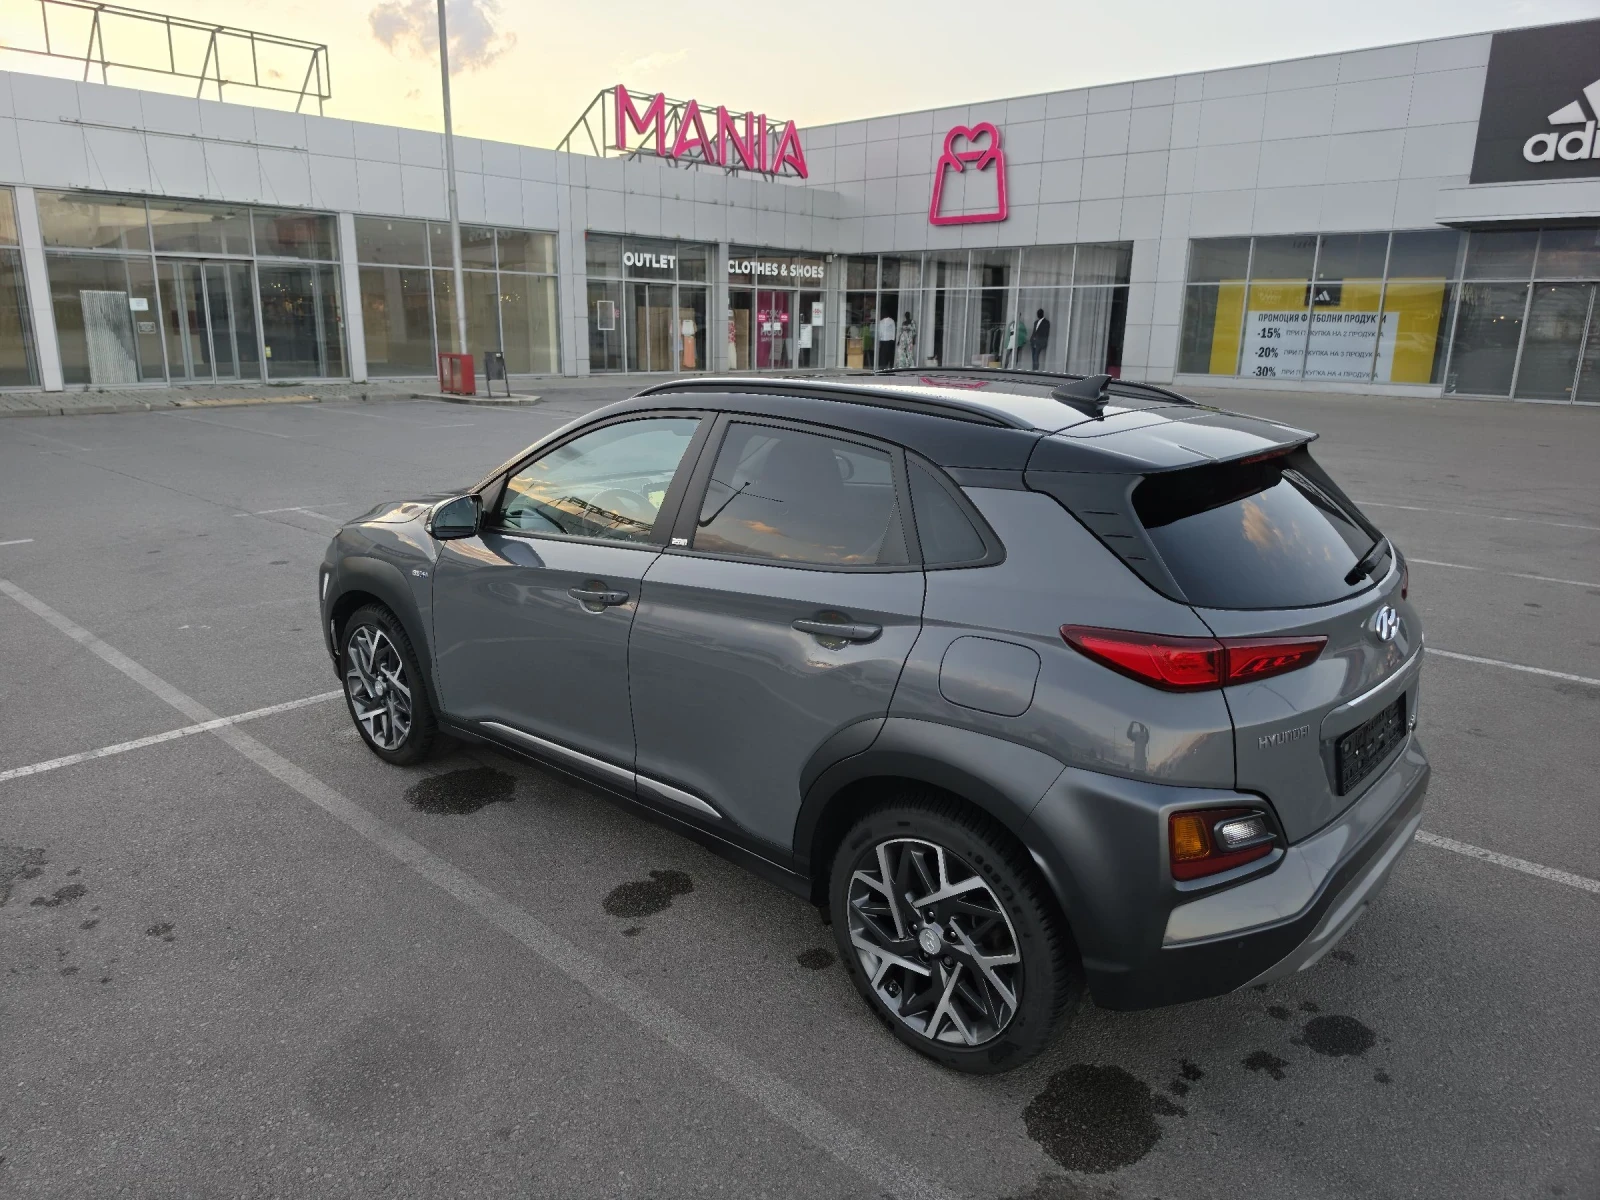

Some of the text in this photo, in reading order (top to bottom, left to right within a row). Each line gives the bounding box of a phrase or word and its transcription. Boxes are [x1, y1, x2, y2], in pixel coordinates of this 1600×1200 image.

[614, 84, 808, 179] MANIA
[624, 252, 676, 269] OUTLET
[728, 259, 824, 279] CLOTHES & SHOES
[1258, 313, 1386, 325] ПРОМОЦИЯ ФТБОЛНИ ПРОДУКИ
[1257, 327, 1281, 338] -15%
[1255, 347, 1279, 358] -20%
[1252, 366, 1276, 377] -30%
[1258, 724, 1310, 750] HYUNDAI
